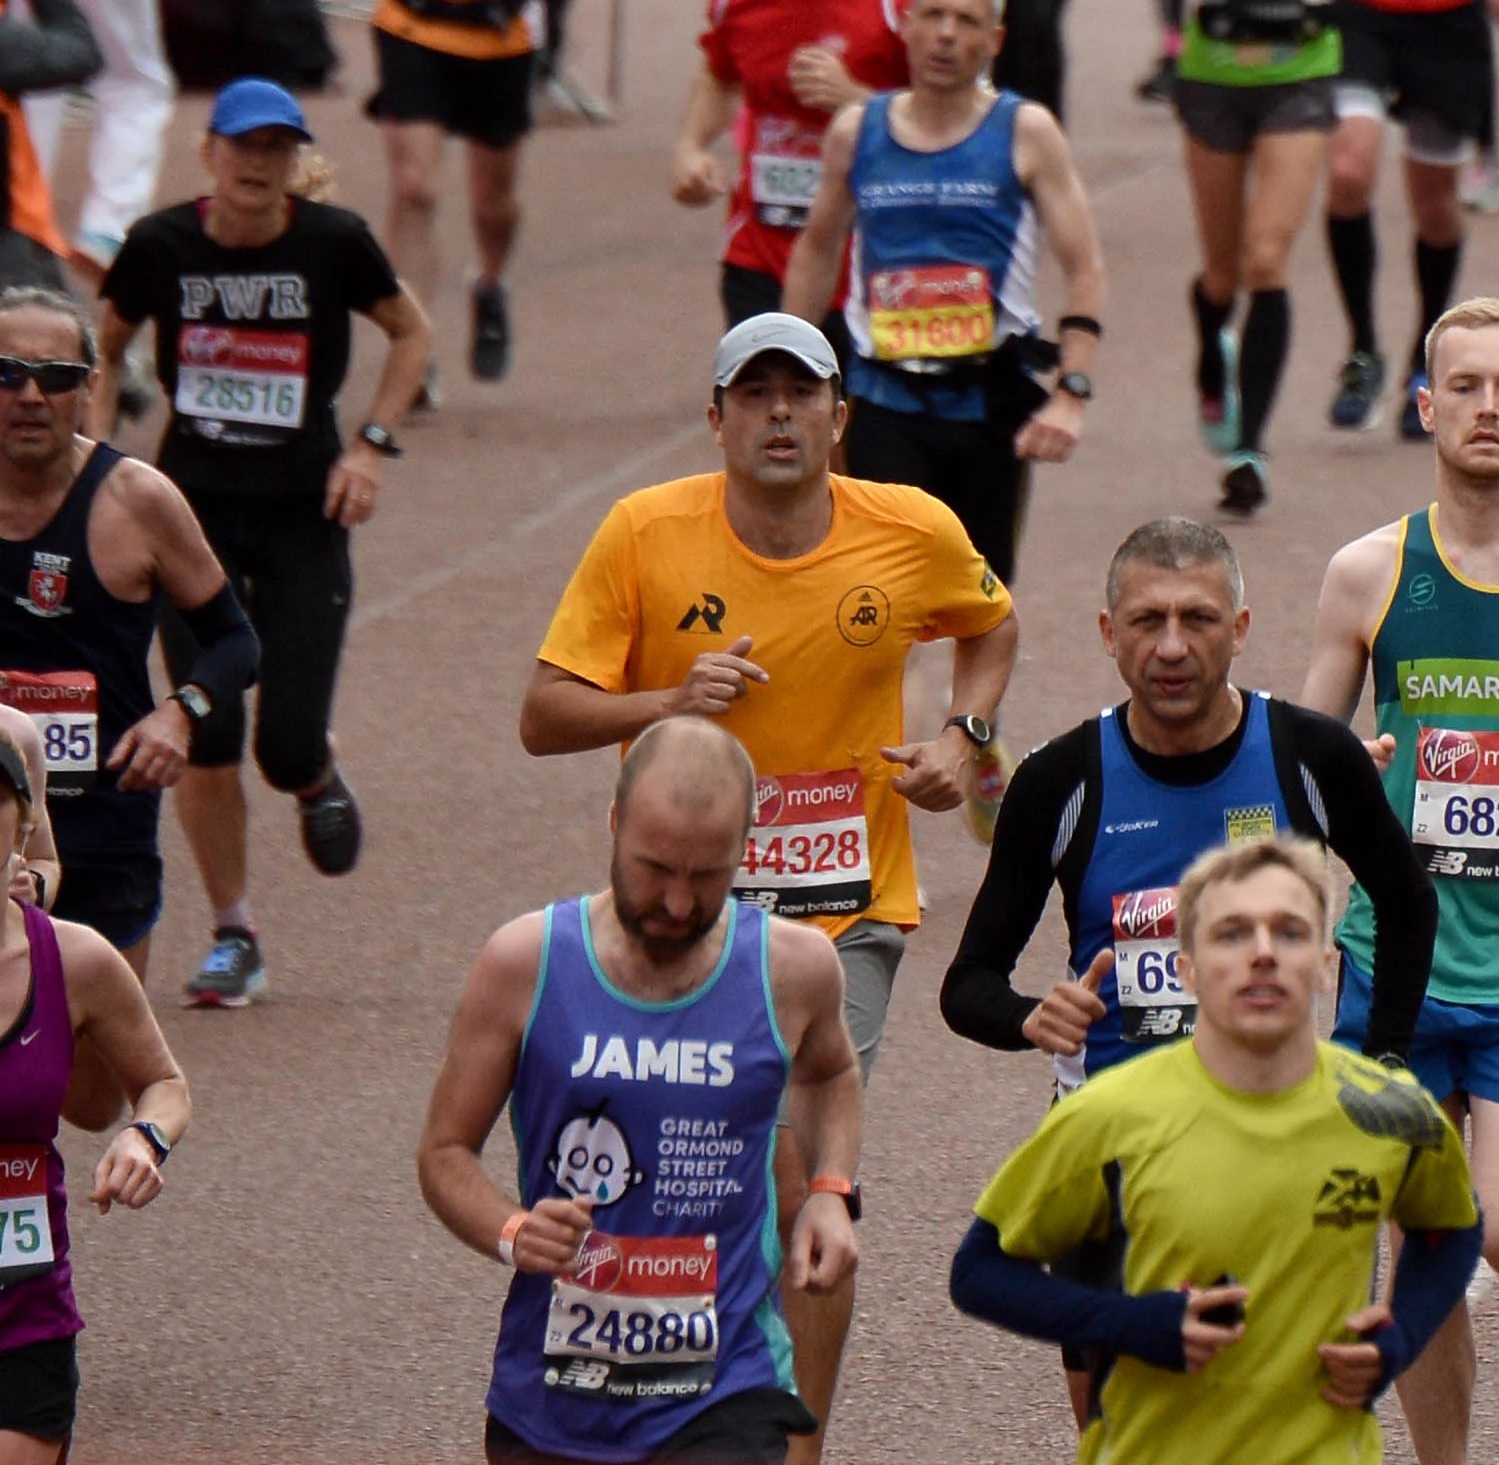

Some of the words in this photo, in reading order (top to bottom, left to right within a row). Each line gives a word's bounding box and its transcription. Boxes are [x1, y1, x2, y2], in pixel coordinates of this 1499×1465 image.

[179, 274, 310, 319] PWR
[196, 374, 294, 417] 28516
[34, 551, 71, 567] KENT
[17, 686, 90, 701] money
[1425, 730, 1476, 778] Virgin
[788, 782, 857, 806] money
[1467, 865, 1493, 878] new
[779, 903, 806, 915] new
[808, 898, 858, 912] balance
[1121, 892, 1177, 935] Virgin
[571, 1034, 734, 1087] JAMES
[660, 1118, 728, 1136] GREAT
[658, 1139, 743, 1156] ORMOND
[657, 1160, 727, 1176] STREET
[654, 1180, 743, 1198] HOSPITAL
[652, 1200, 724, 1217] CHARITY
[628, 1251, 712, 1283] money
[567, 1303, 714, 1355] 24880
[607, 1383, 634, 1396] new
[637, 1382, 697, 1395] balance
